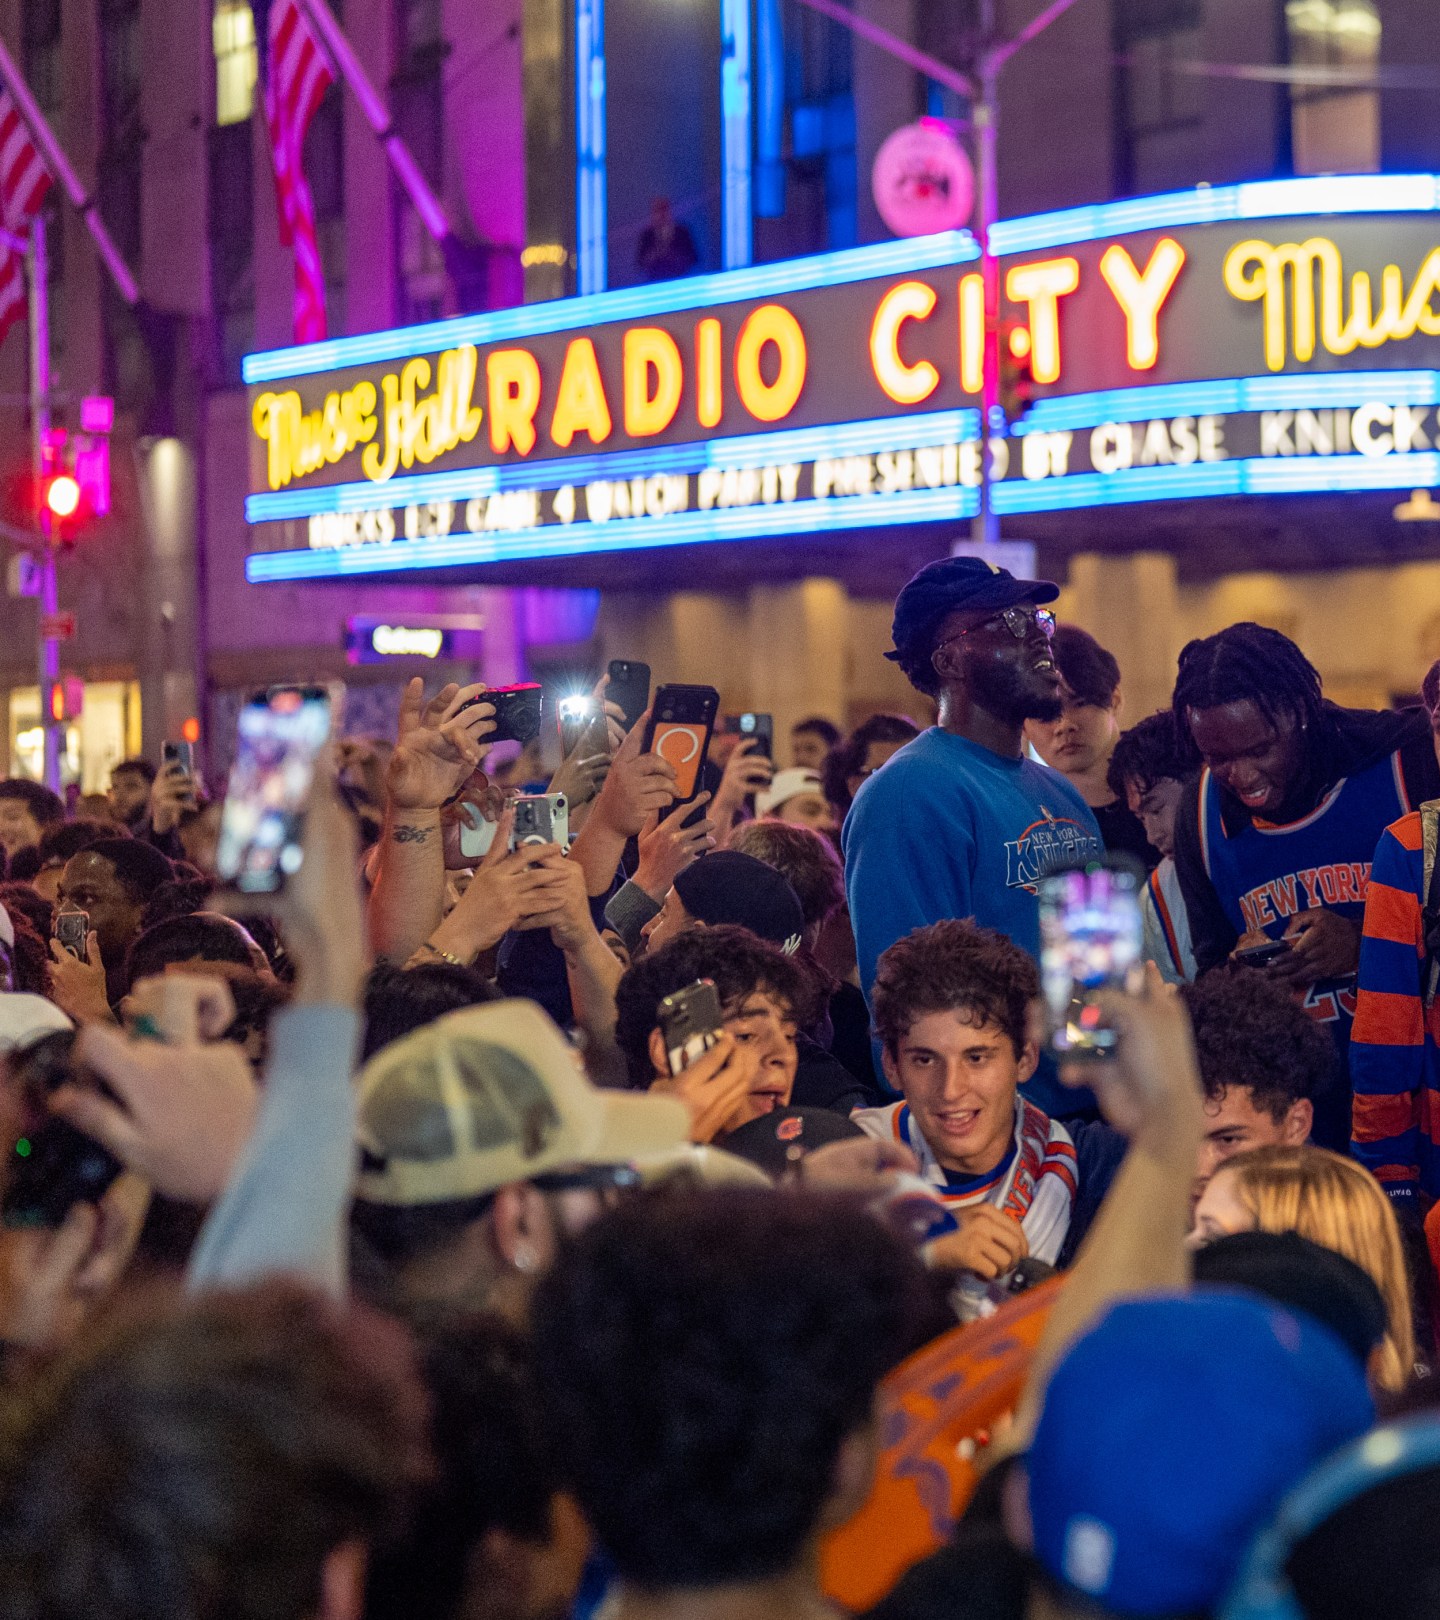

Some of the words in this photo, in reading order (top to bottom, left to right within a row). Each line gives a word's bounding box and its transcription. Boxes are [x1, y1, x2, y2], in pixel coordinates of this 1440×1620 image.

[253, 381, 377, 490] Music
[362, 343, 482, 483] Hall
[486, 303, 806, 456] RADIO
[870, 237, 1186, 403] CITY
[552, 485, 576, 525] 4
[698, 463, 801, 511] PARTY
[813, 437, 1009, 499] PRESENTED
[1022, 430, 1073, 480] BY
[1090, 414, 1228, 475] CHASE
[1031, 831, 1054, 845] NEW
[1056, 827, 1080, 840] YORK
[1238, 873, 1299, 934] NEW
[1297, 862, 1373, 909] YORK
